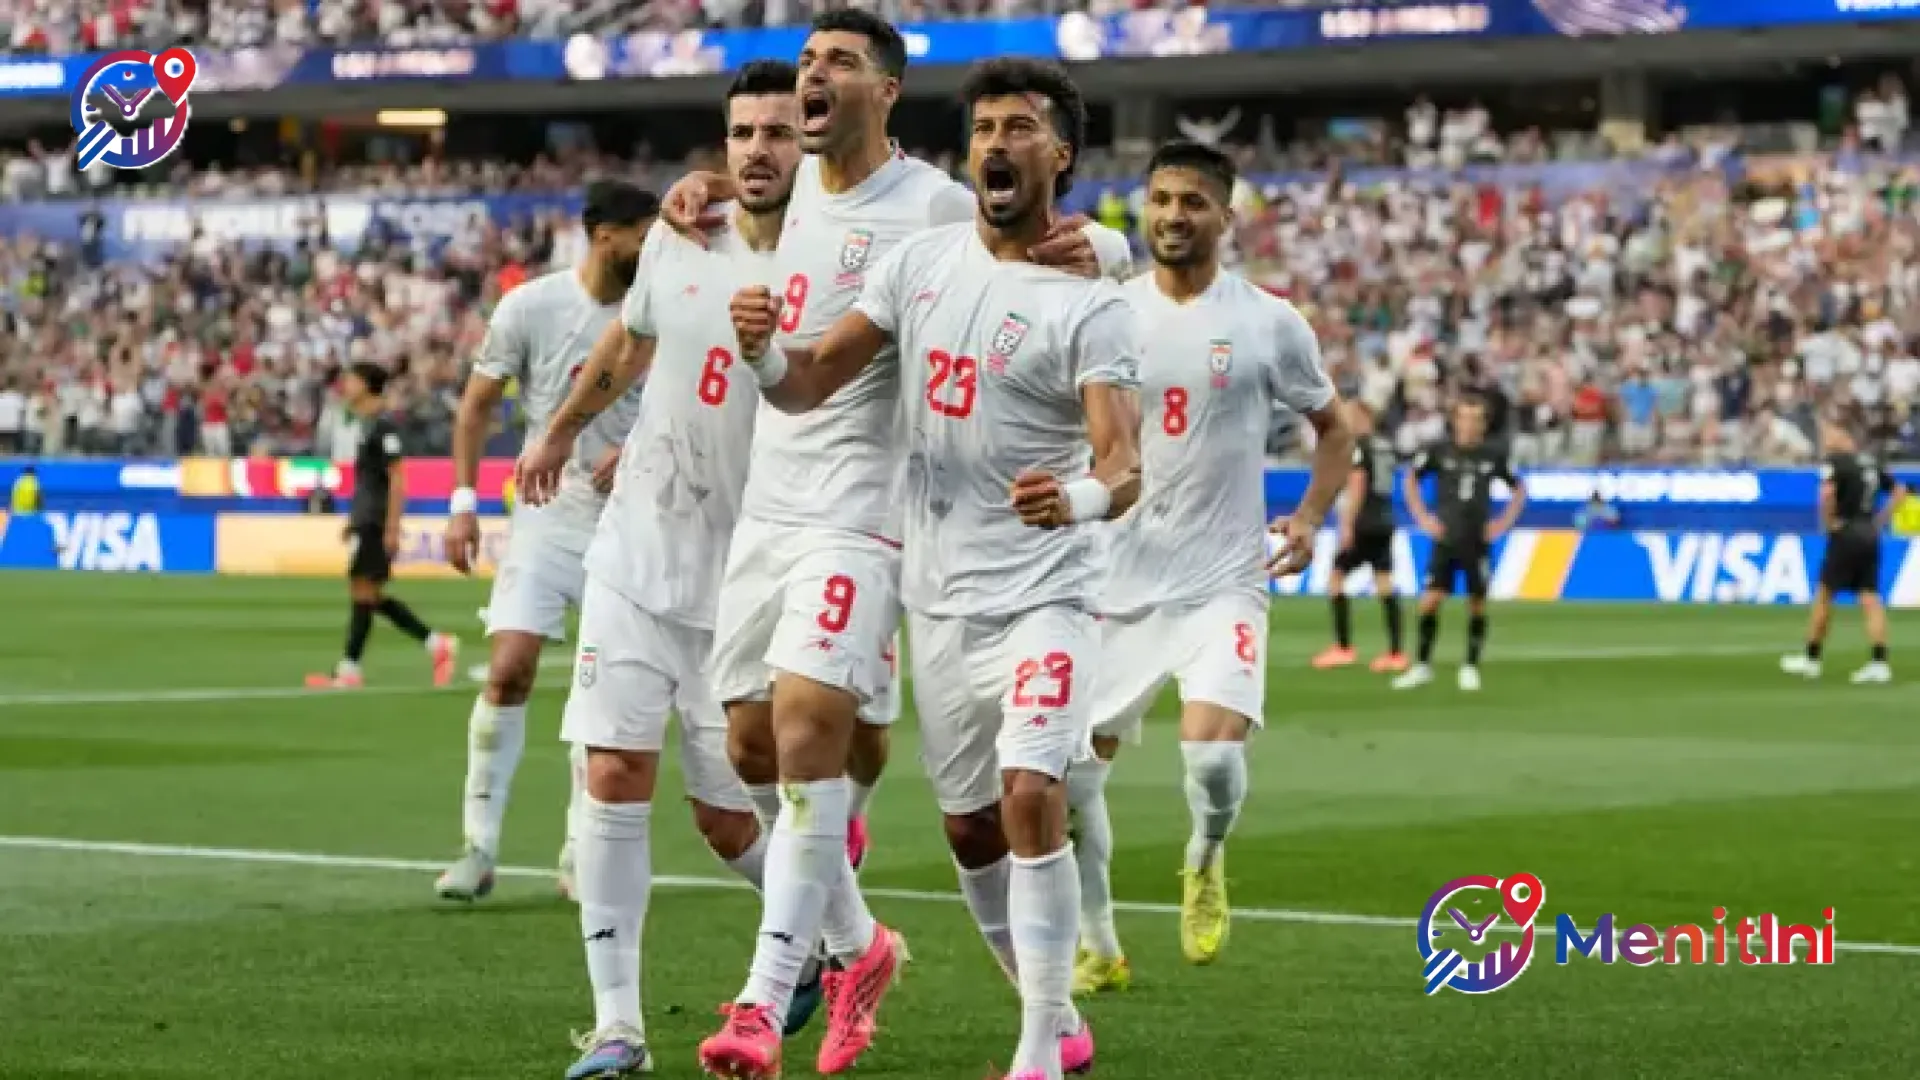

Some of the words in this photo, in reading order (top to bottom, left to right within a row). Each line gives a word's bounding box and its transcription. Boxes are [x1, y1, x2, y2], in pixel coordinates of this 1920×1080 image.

[779, 273, 808, 333] 9
[698, 347, 733, 406] 6
[927, 349, 976, 419] 23
[1163, 386, 1188, 436] 8
[45, 512, 163, 573] VISA
[1632, 531, 1811, 604] VISA
[817, 573, 856, 633] 9
[1013, 650, 1073, 708] 23
